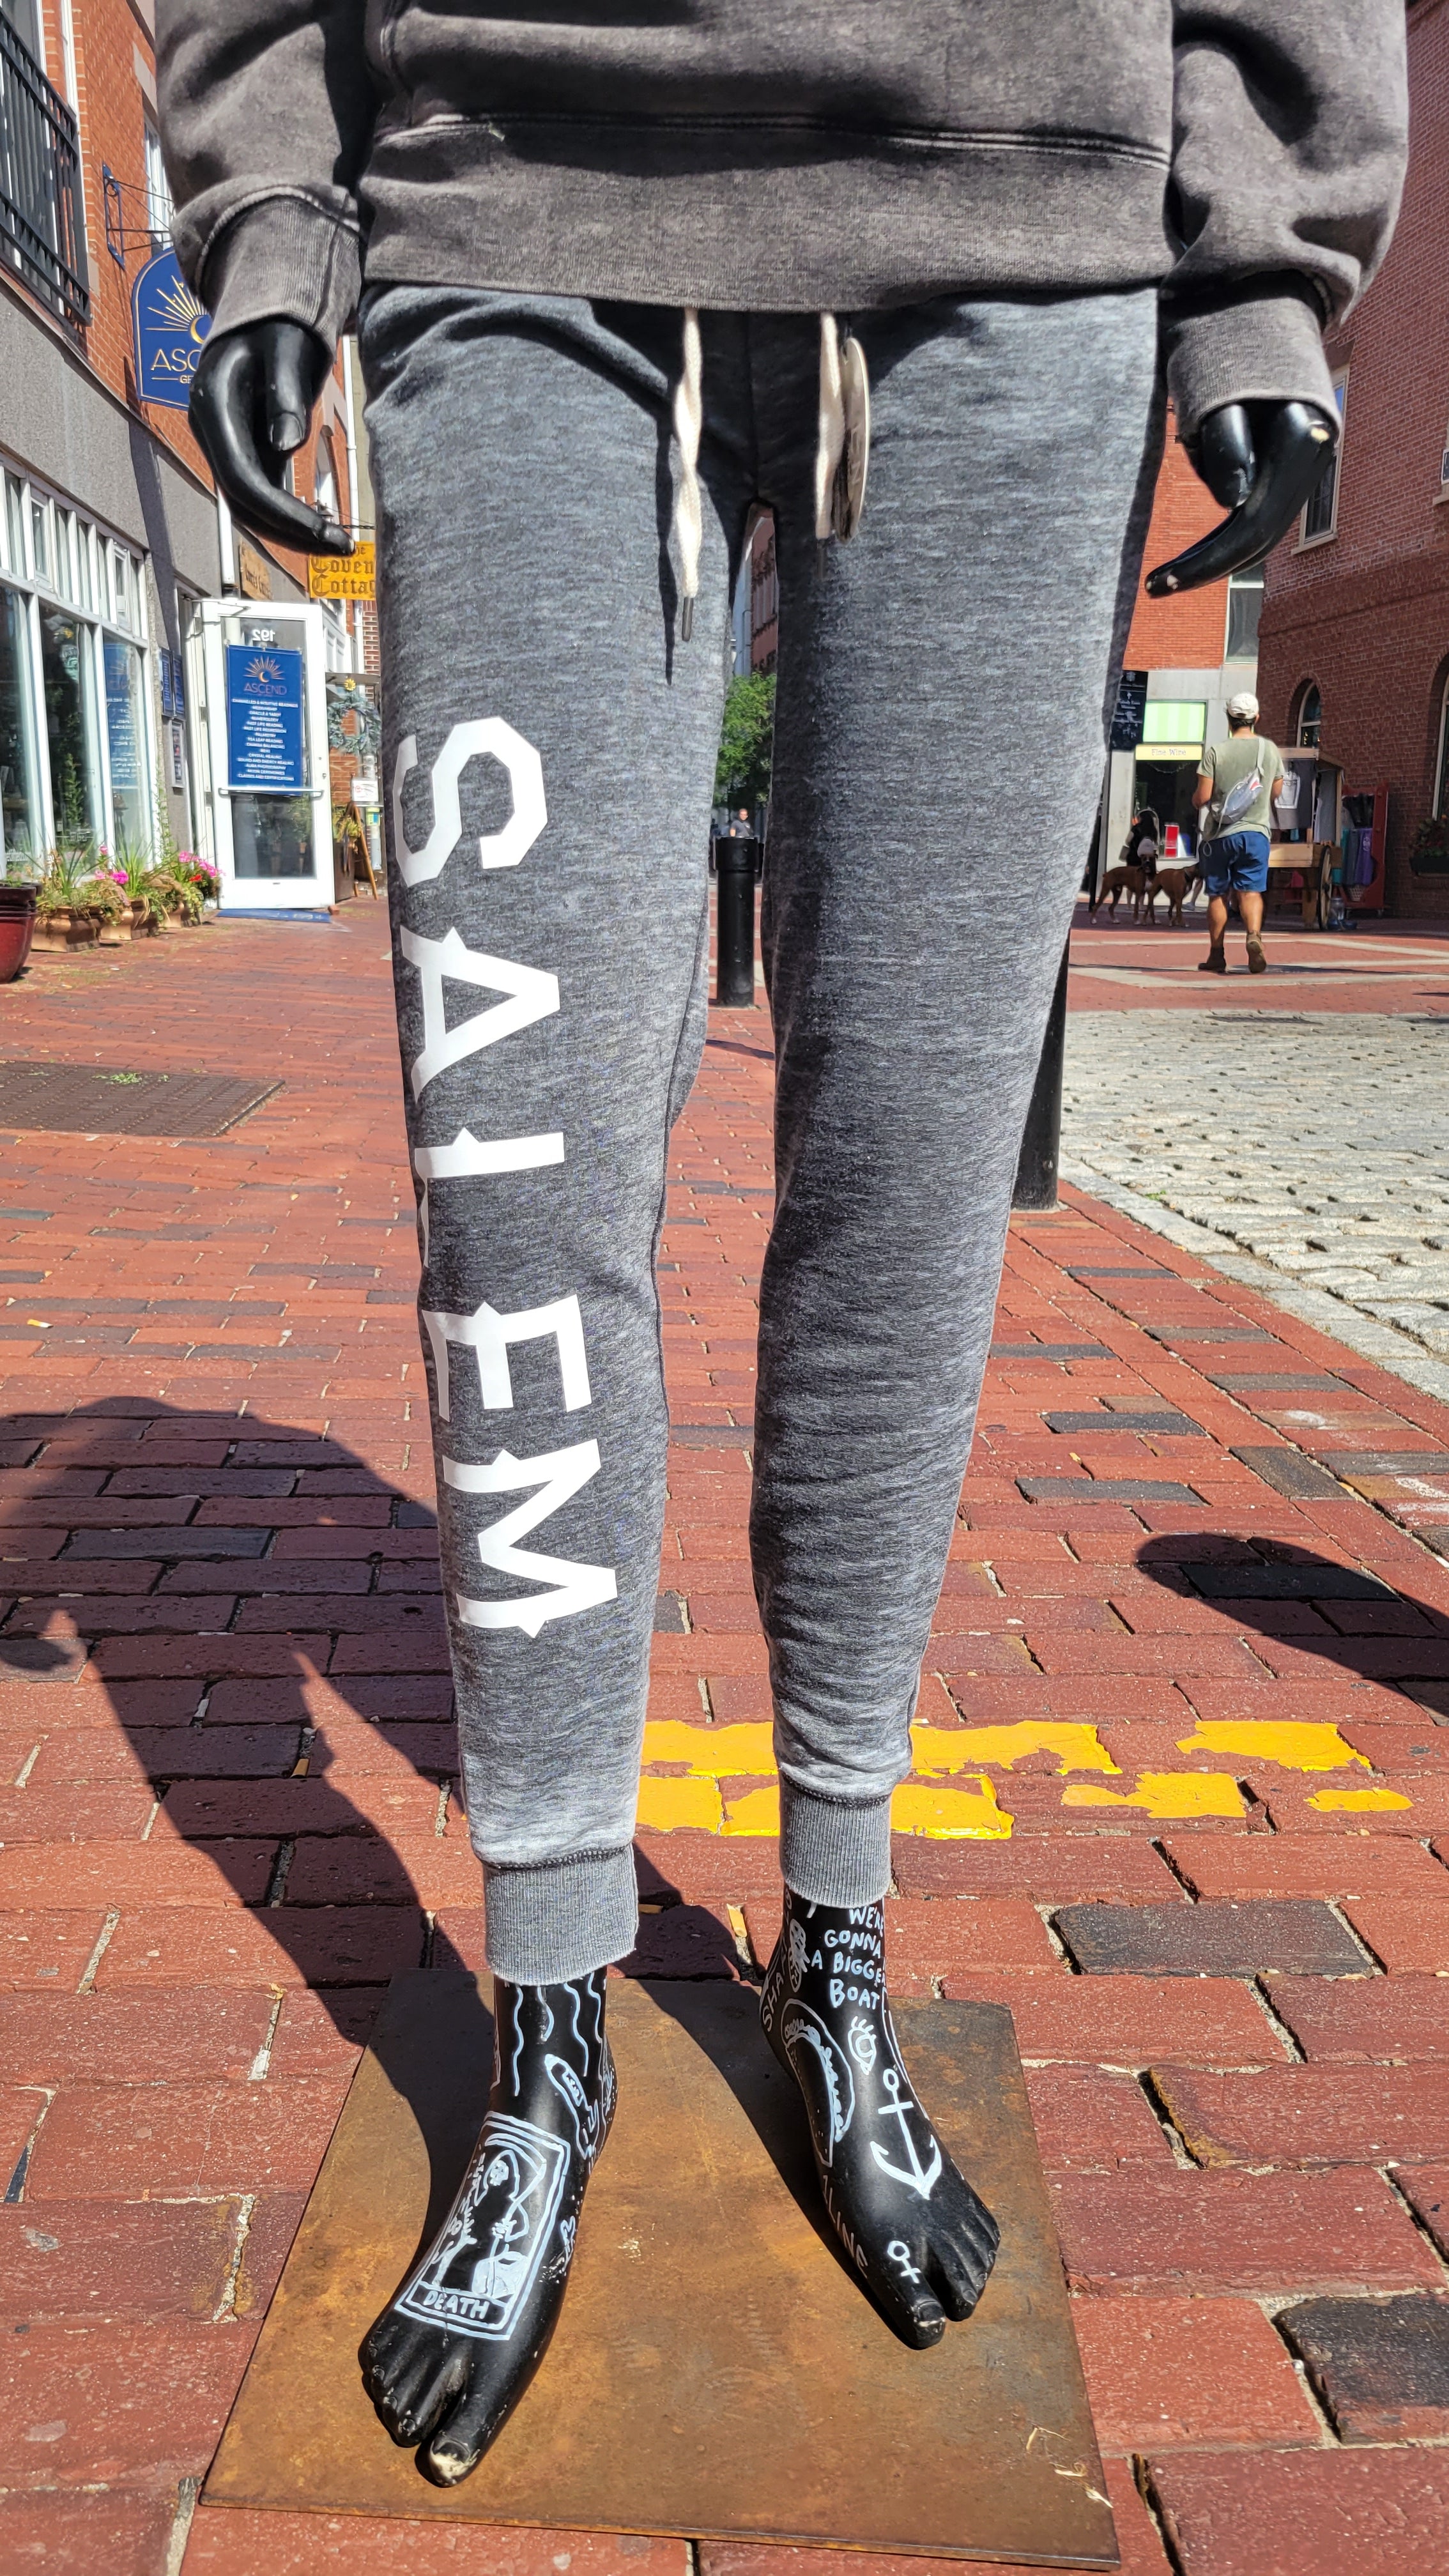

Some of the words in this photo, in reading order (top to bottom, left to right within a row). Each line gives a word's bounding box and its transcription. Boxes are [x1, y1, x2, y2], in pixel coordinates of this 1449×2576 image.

[151, 348, 201, 372] ASC
[312, 574, 376, 598] Cottag
[243, 682, 288, 695] ASCEND
[391, 716, 618, 1639] SALEM
[824, 1929, 881, 1959] GONNA
[811, 1949, 823, 1970] A
[830, 1979, 880, 2009] BOAT
[423, 2290, 489, 2319] DEATH
